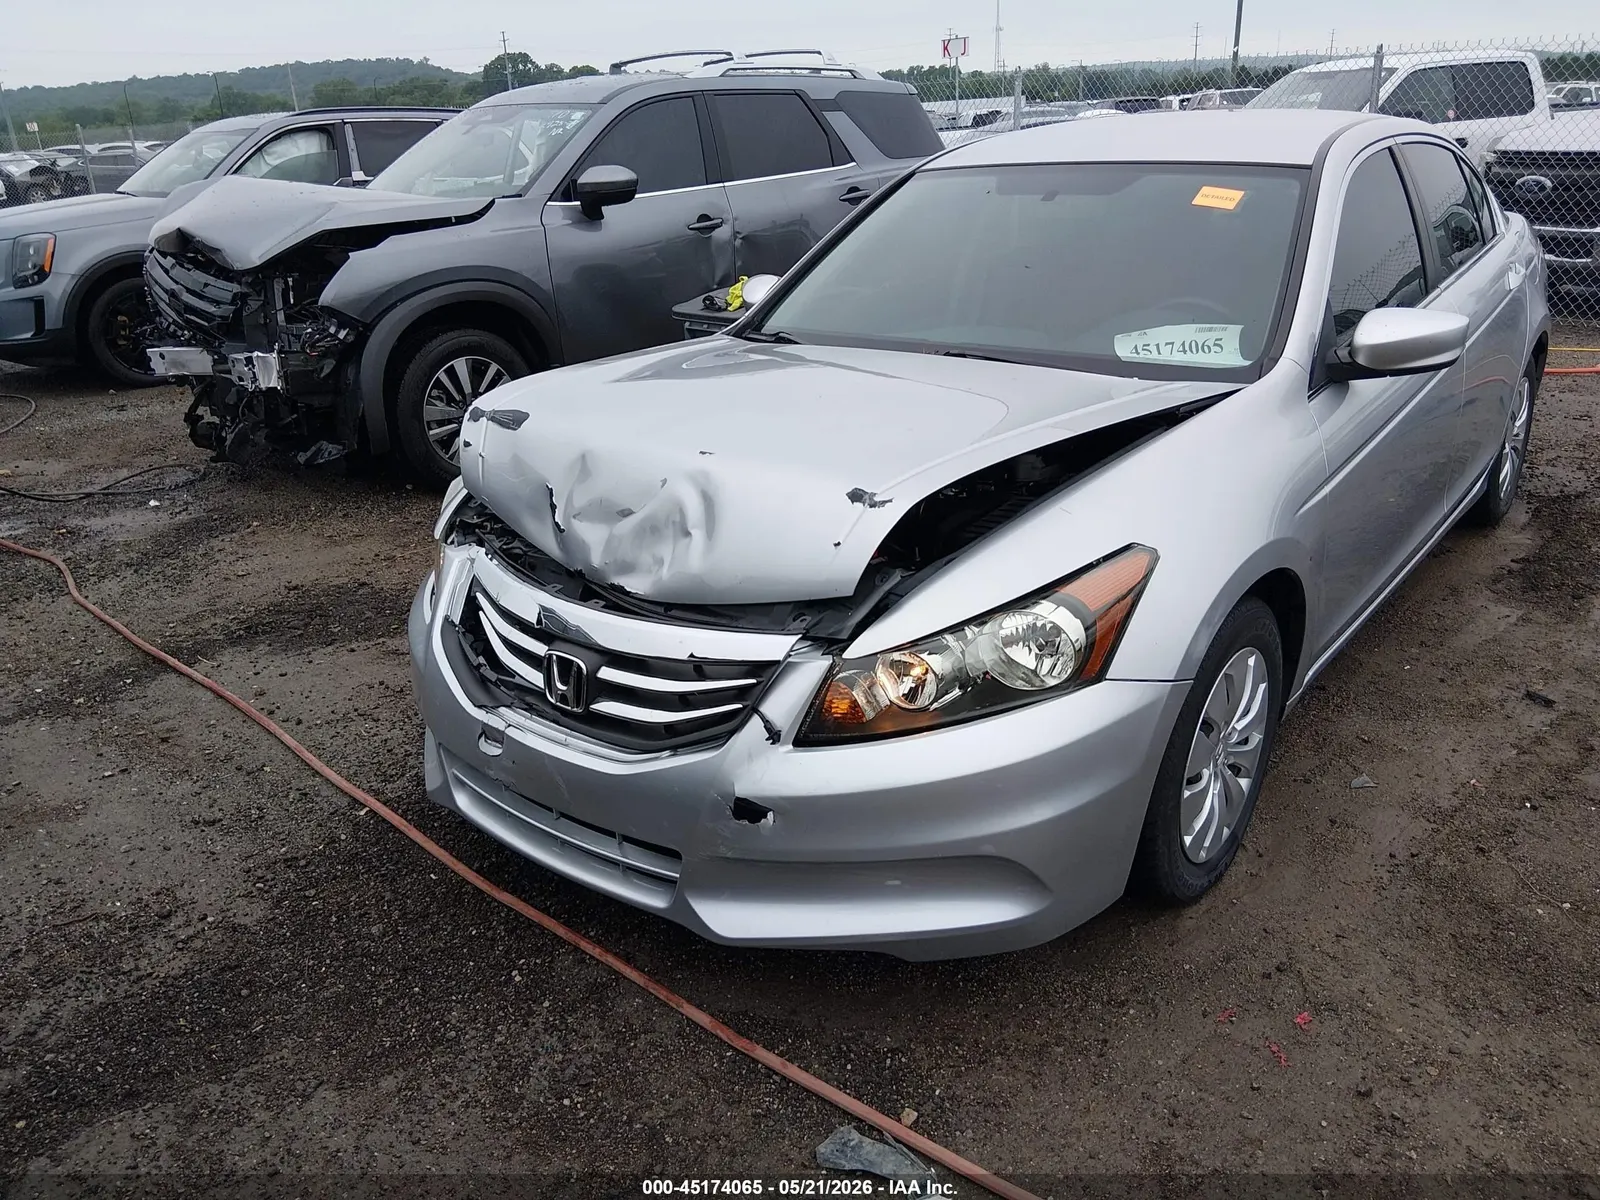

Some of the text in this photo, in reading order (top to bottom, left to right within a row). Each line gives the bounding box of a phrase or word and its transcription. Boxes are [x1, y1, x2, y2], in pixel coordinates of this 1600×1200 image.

[943, 38, 966, 57] K J
[1200, 193, 1236, 202] DETAILED
[1130, 338, 1224, 356] 45174065
